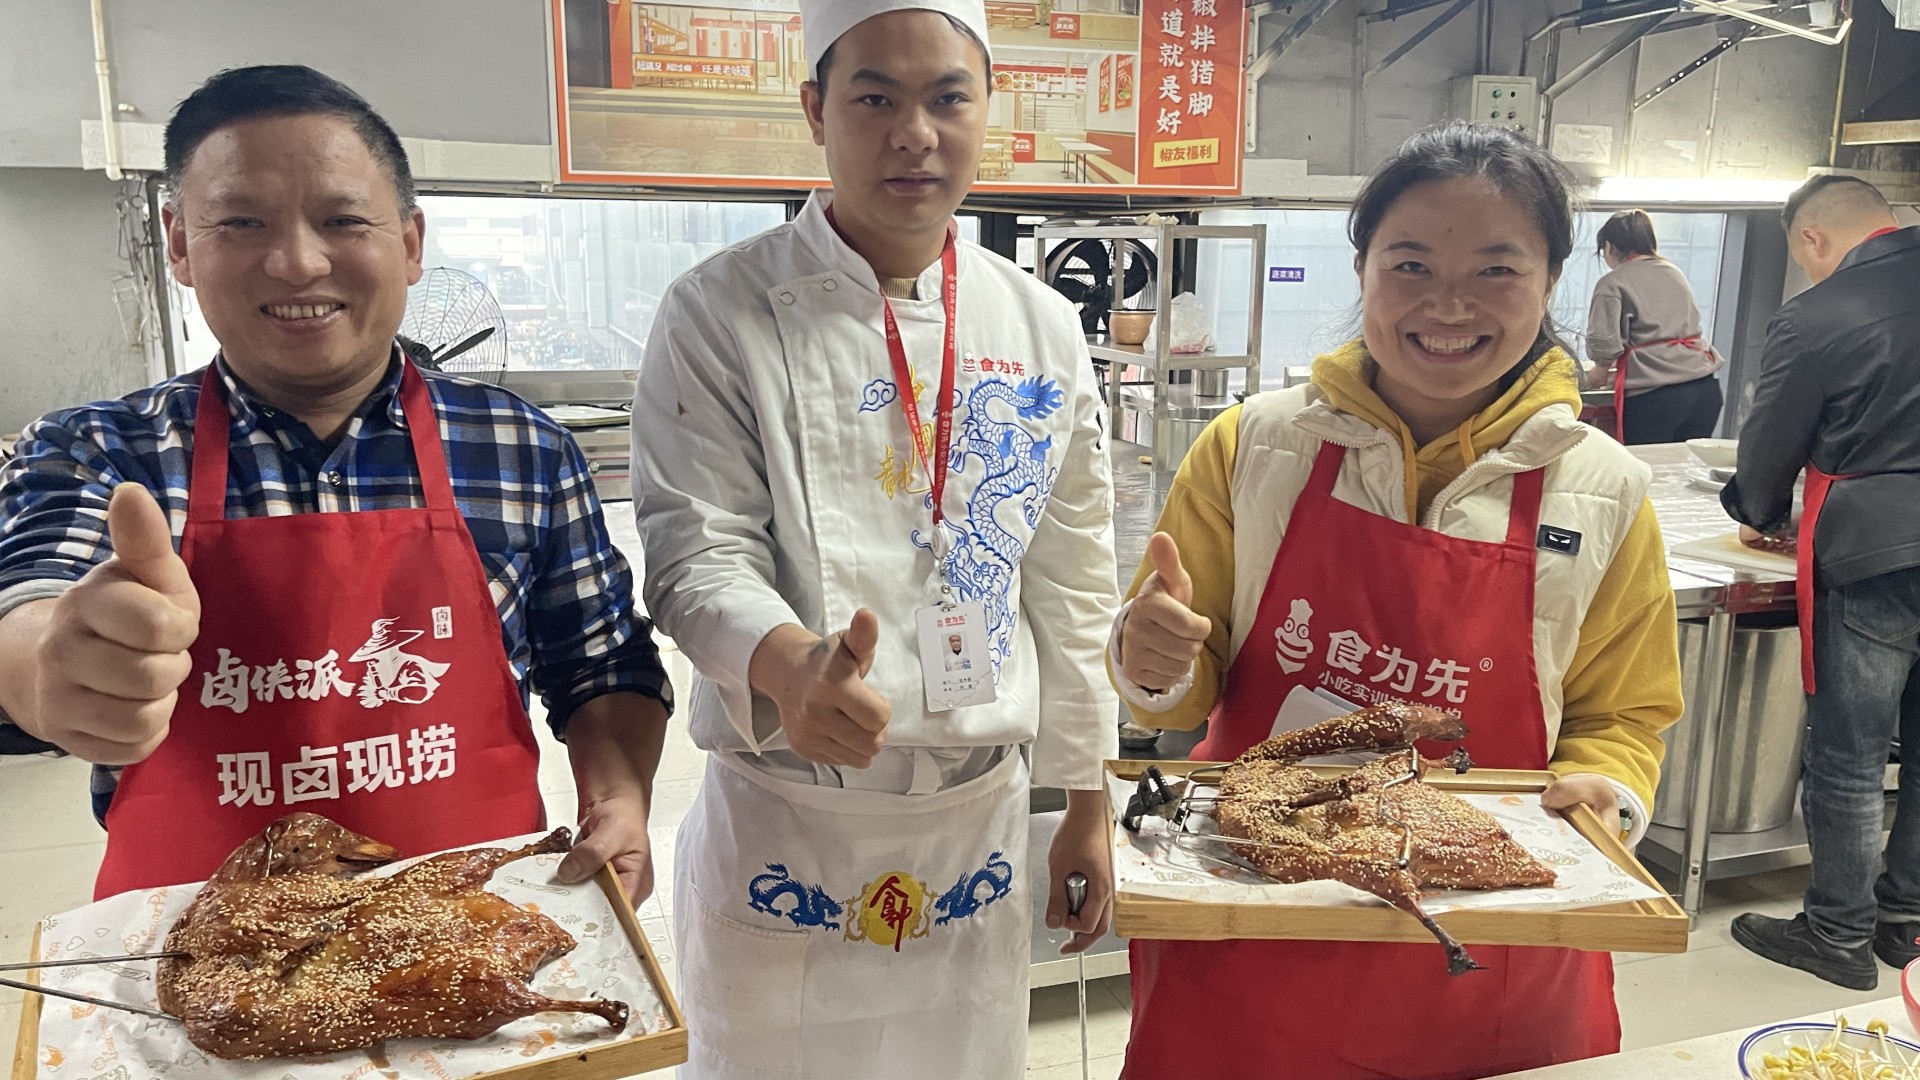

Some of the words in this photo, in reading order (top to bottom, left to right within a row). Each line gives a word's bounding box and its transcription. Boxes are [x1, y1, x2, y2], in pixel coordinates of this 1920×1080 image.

[1156, 0, 1186, 136] 道就是好
[979, 357, 1025, 377] 食为先
[435, 608, 449, 637] 卤味
[200, 648, 356, 713] 卤侠派
[1325, 629, 1471, 704] 食为先
[216, 723, 457, 808] 现卤现捞
